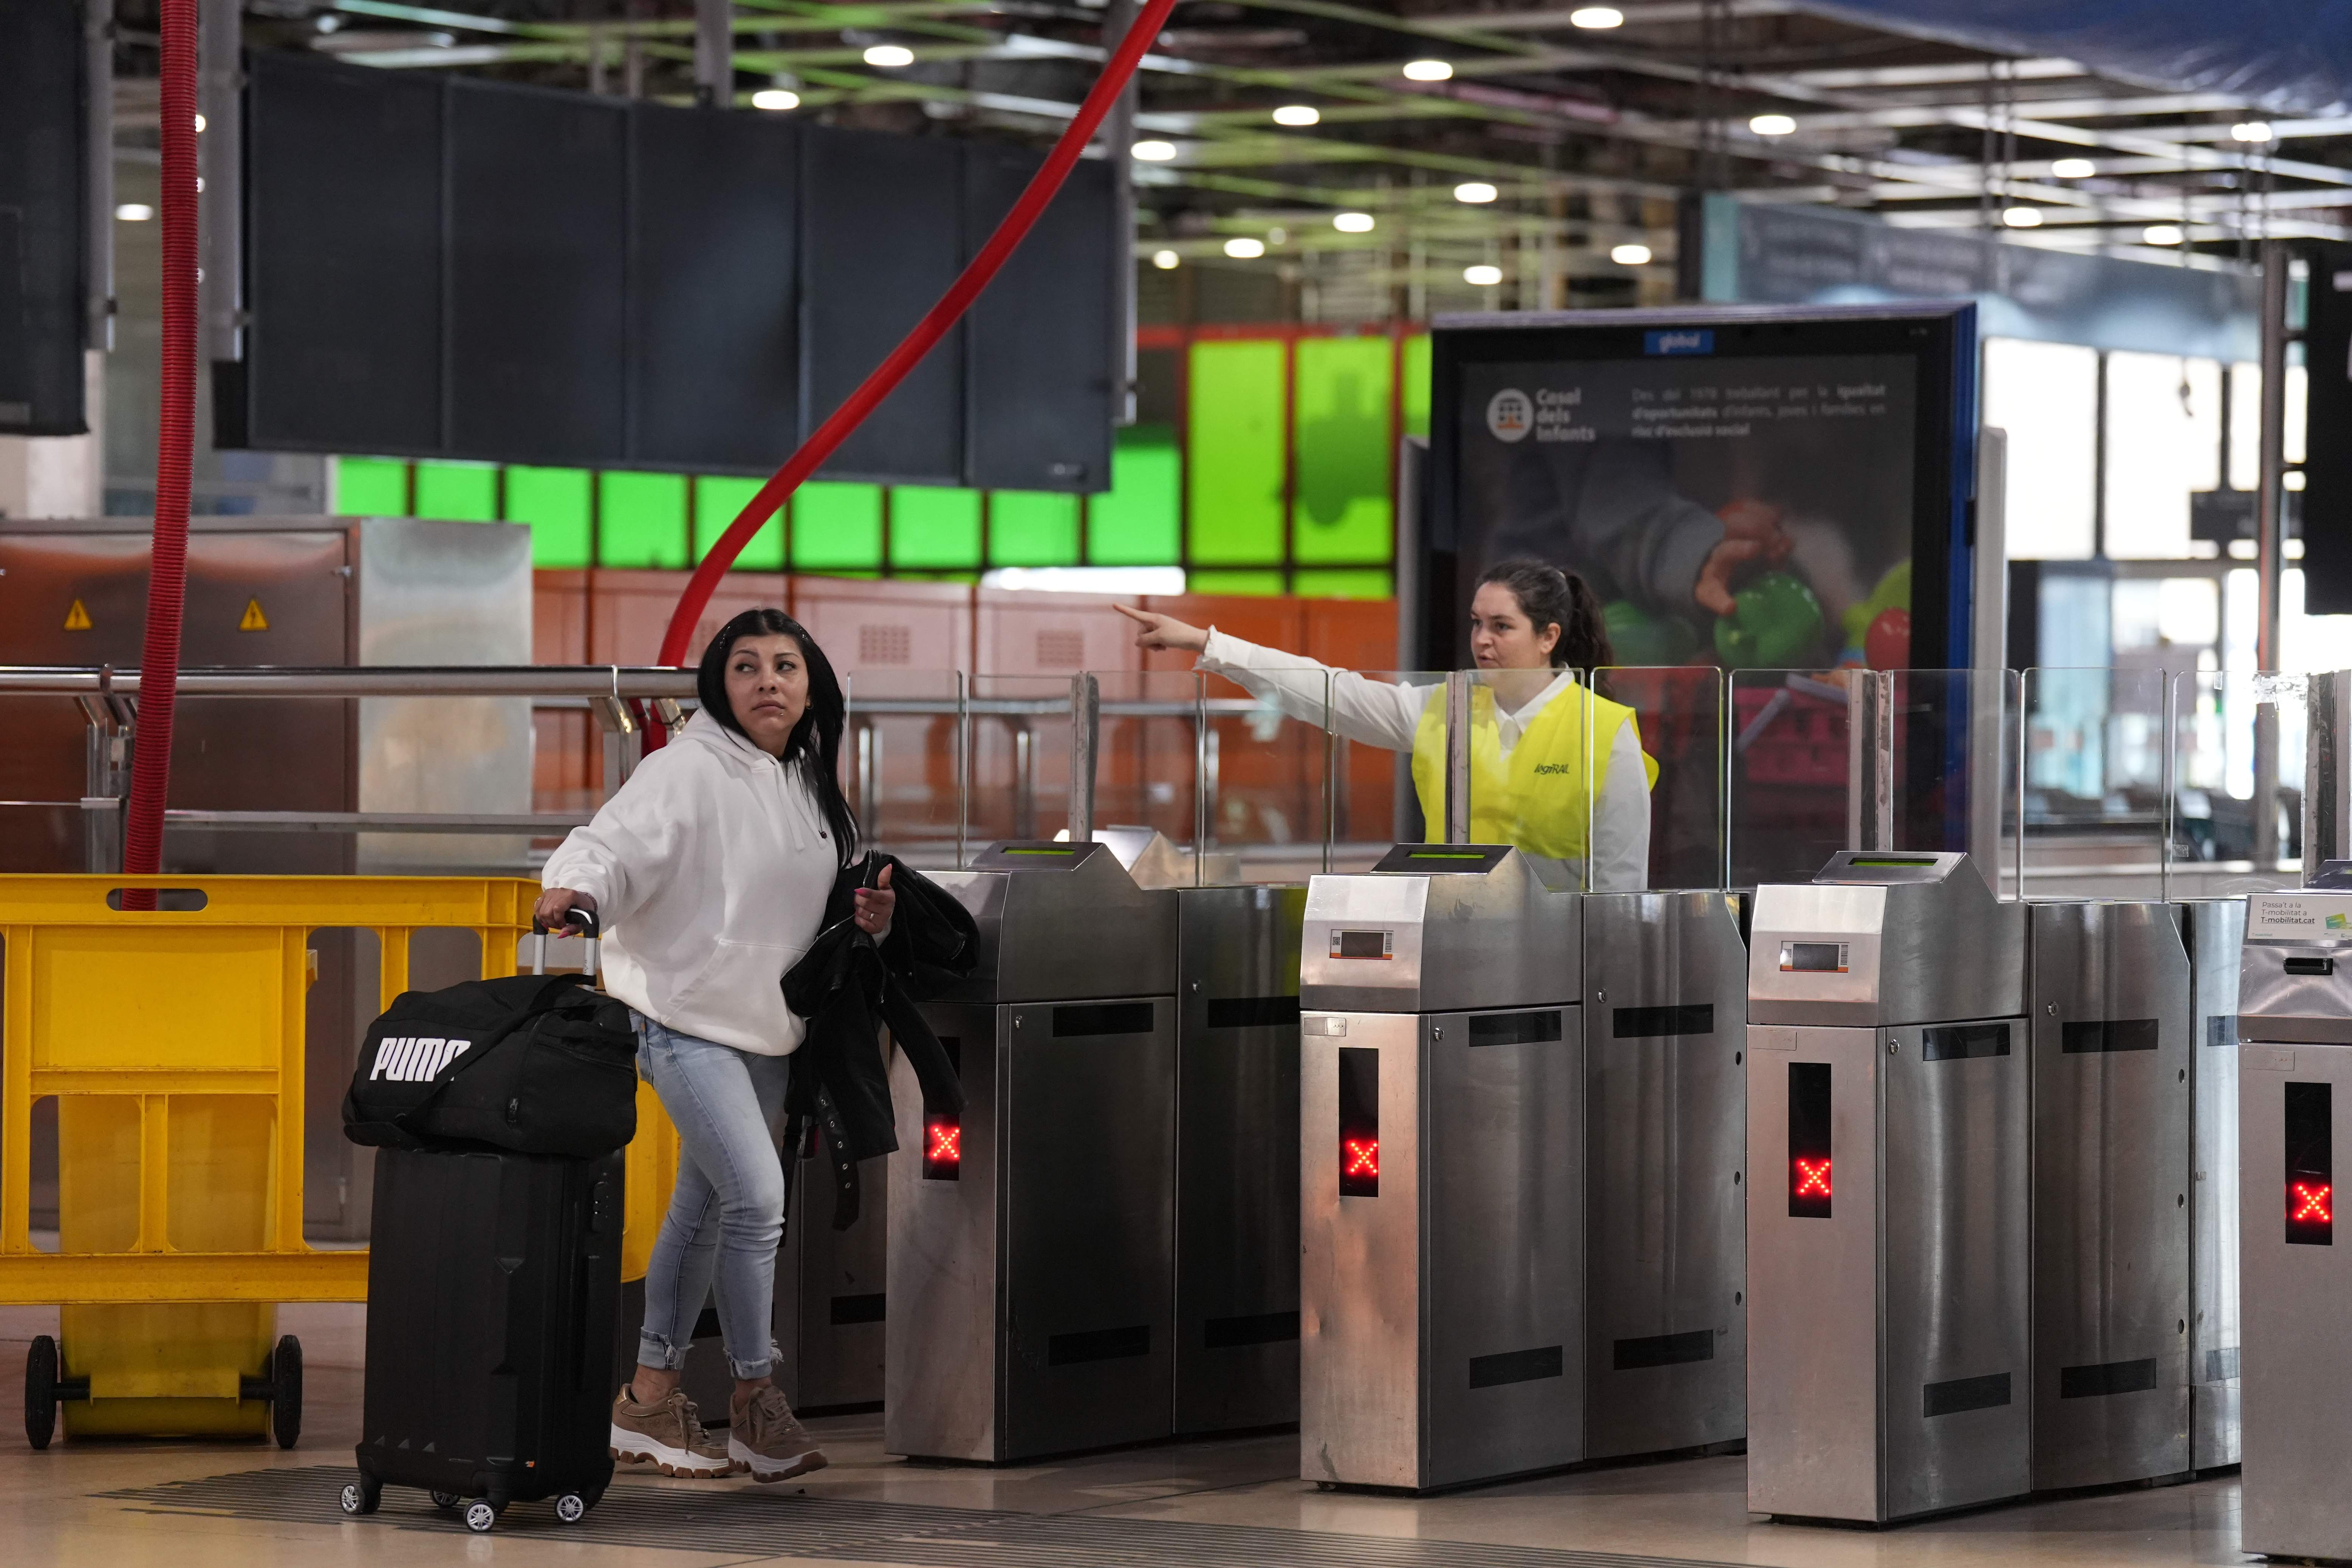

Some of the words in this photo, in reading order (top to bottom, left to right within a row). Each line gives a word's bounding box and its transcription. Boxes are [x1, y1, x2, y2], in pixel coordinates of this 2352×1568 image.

[1535, 387, 1581, 405] Casal
[1537, 407, 1571, 423] dels
[1536, 425, 1596, 443] Infants
